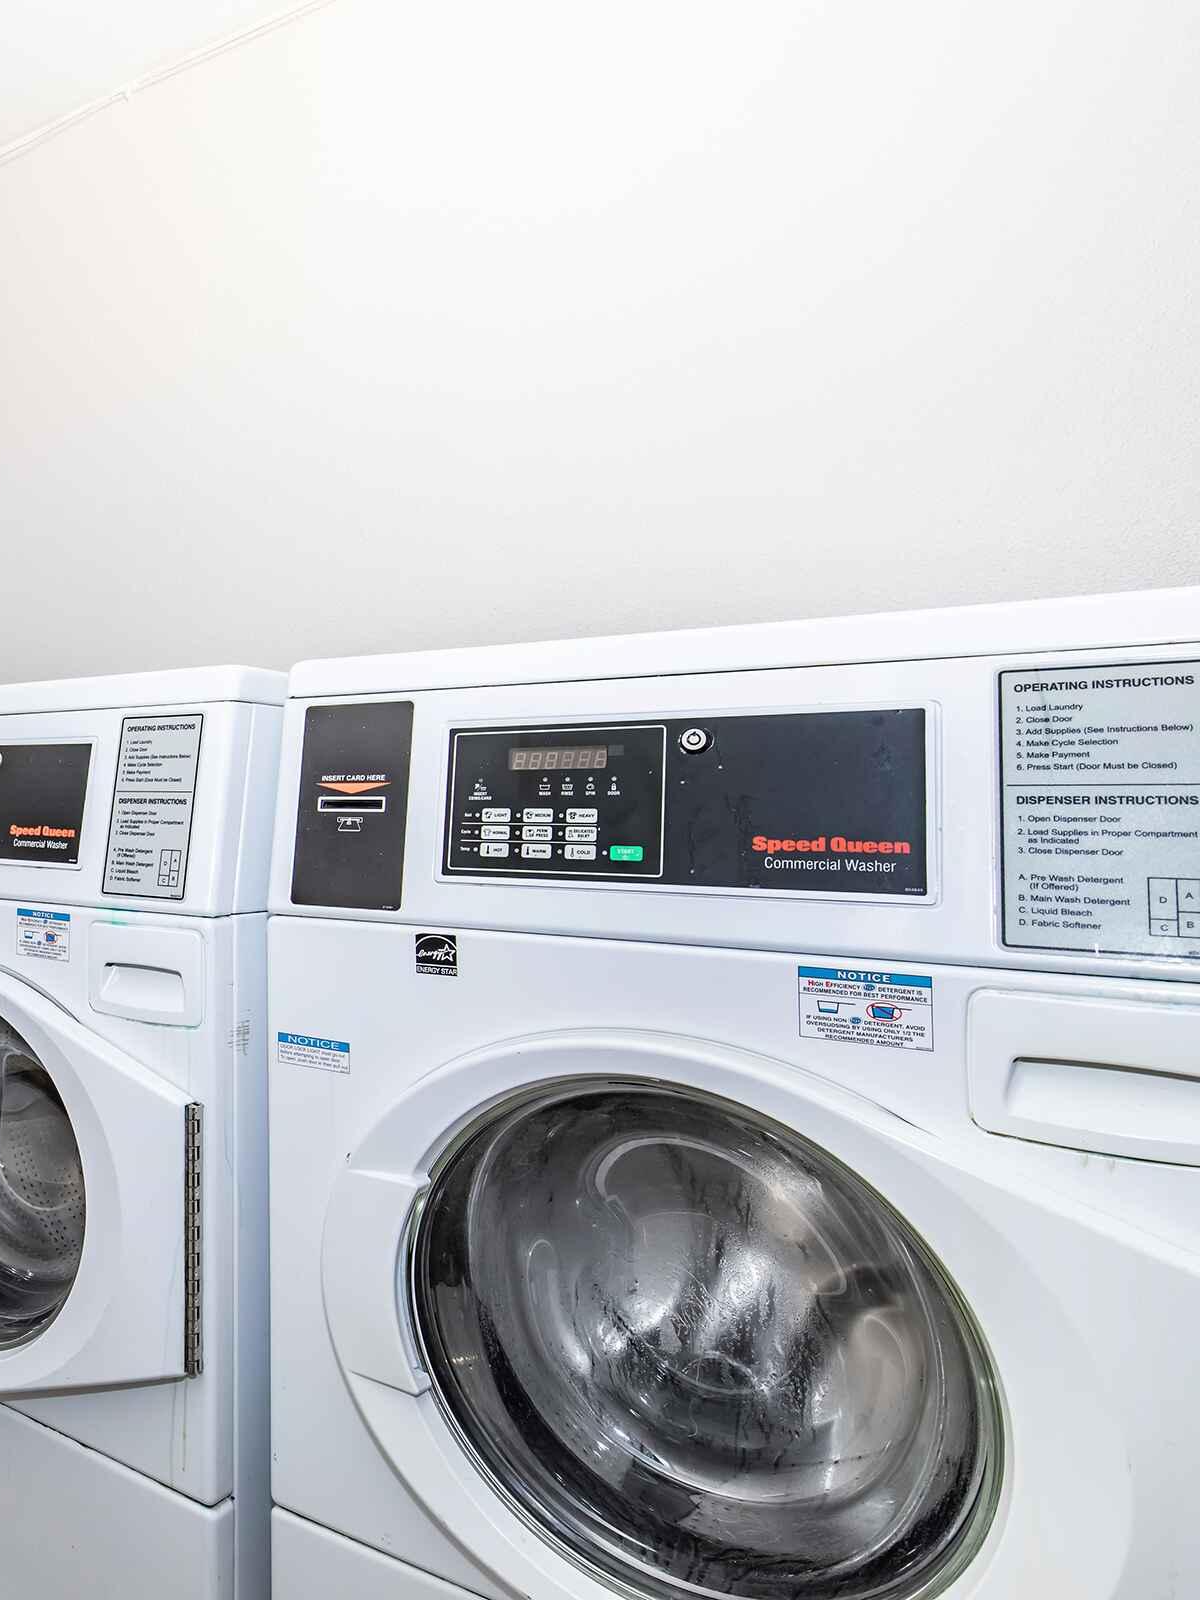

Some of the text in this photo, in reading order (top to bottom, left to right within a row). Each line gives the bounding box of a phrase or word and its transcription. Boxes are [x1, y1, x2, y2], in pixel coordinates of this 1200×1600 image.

[1014, 676, 1194, 692] OPERATING INSTRUCTIONS
[1025, 704, 1046, 712] Load
[1049, 703, 1083, 712] Laundry
[1045, 727, 1081, 735] Supplies
[1084, 727, 1104, 735] (See
[1161, 724, 1194, 732] Below)
[1052, 739, 1075, 747] Cycle
[1078, 738, 1118, 746] Selection
[1052, 751, 1090, 759] Payment
[1076, 762, 1100, 771] (Door
[1103, 762, 1125, 770] Must
[1016, 795, 1199, 805] DISPENSER INSTRUCTIONS
[1028, 815, 1050, 823] Open
[10, 825, 75, 837] Speed Queen
[1051, 829, 1089, 837] Supplies
[1101, 830, 1131, 838] Proper
[1134, 830, 1198, 838] Compartment
[14, 838, 68, 849] Commercial Washer
[752, 835, 911, 854] Speed Queen
[1055, 848, 1099, 856] Dispenser
[764, 857, 896, 873] Commercial Washer
[1078, 876, 1124, 885] Detergent
[1042, 883, 1079, 891] Offered)
[1054, 896, 1080, 904] Wash
[1084, 897, 1130, 906] Detergent
[1031, 907, 1058, 916] Liquid
[1061, 908, 1093, 917] Bleach
[1031, 919, 1060, 928] Fabric
[1062, 920, 1101, 930] Softener
[1187, 921, 1194, 929] B
[837, 971, 891, 982] NOTICE
[825, 981, 860, 990] EFFICIENCY
[878, 987, 914, 995] DETERGENT
[803, 986, 848, 995] RECOMMENDED
[880, 994, 927, 1003] PERFORMANCE
[806, 1021, 850, 1029] OVERSUDSING
[817, 1027, 913, 1042] DETERGENT MANUFACTURERS
[825, 1034, 875, 1044] RECOMMENDED
[288, 1035, 340, 1049] NOTICE
